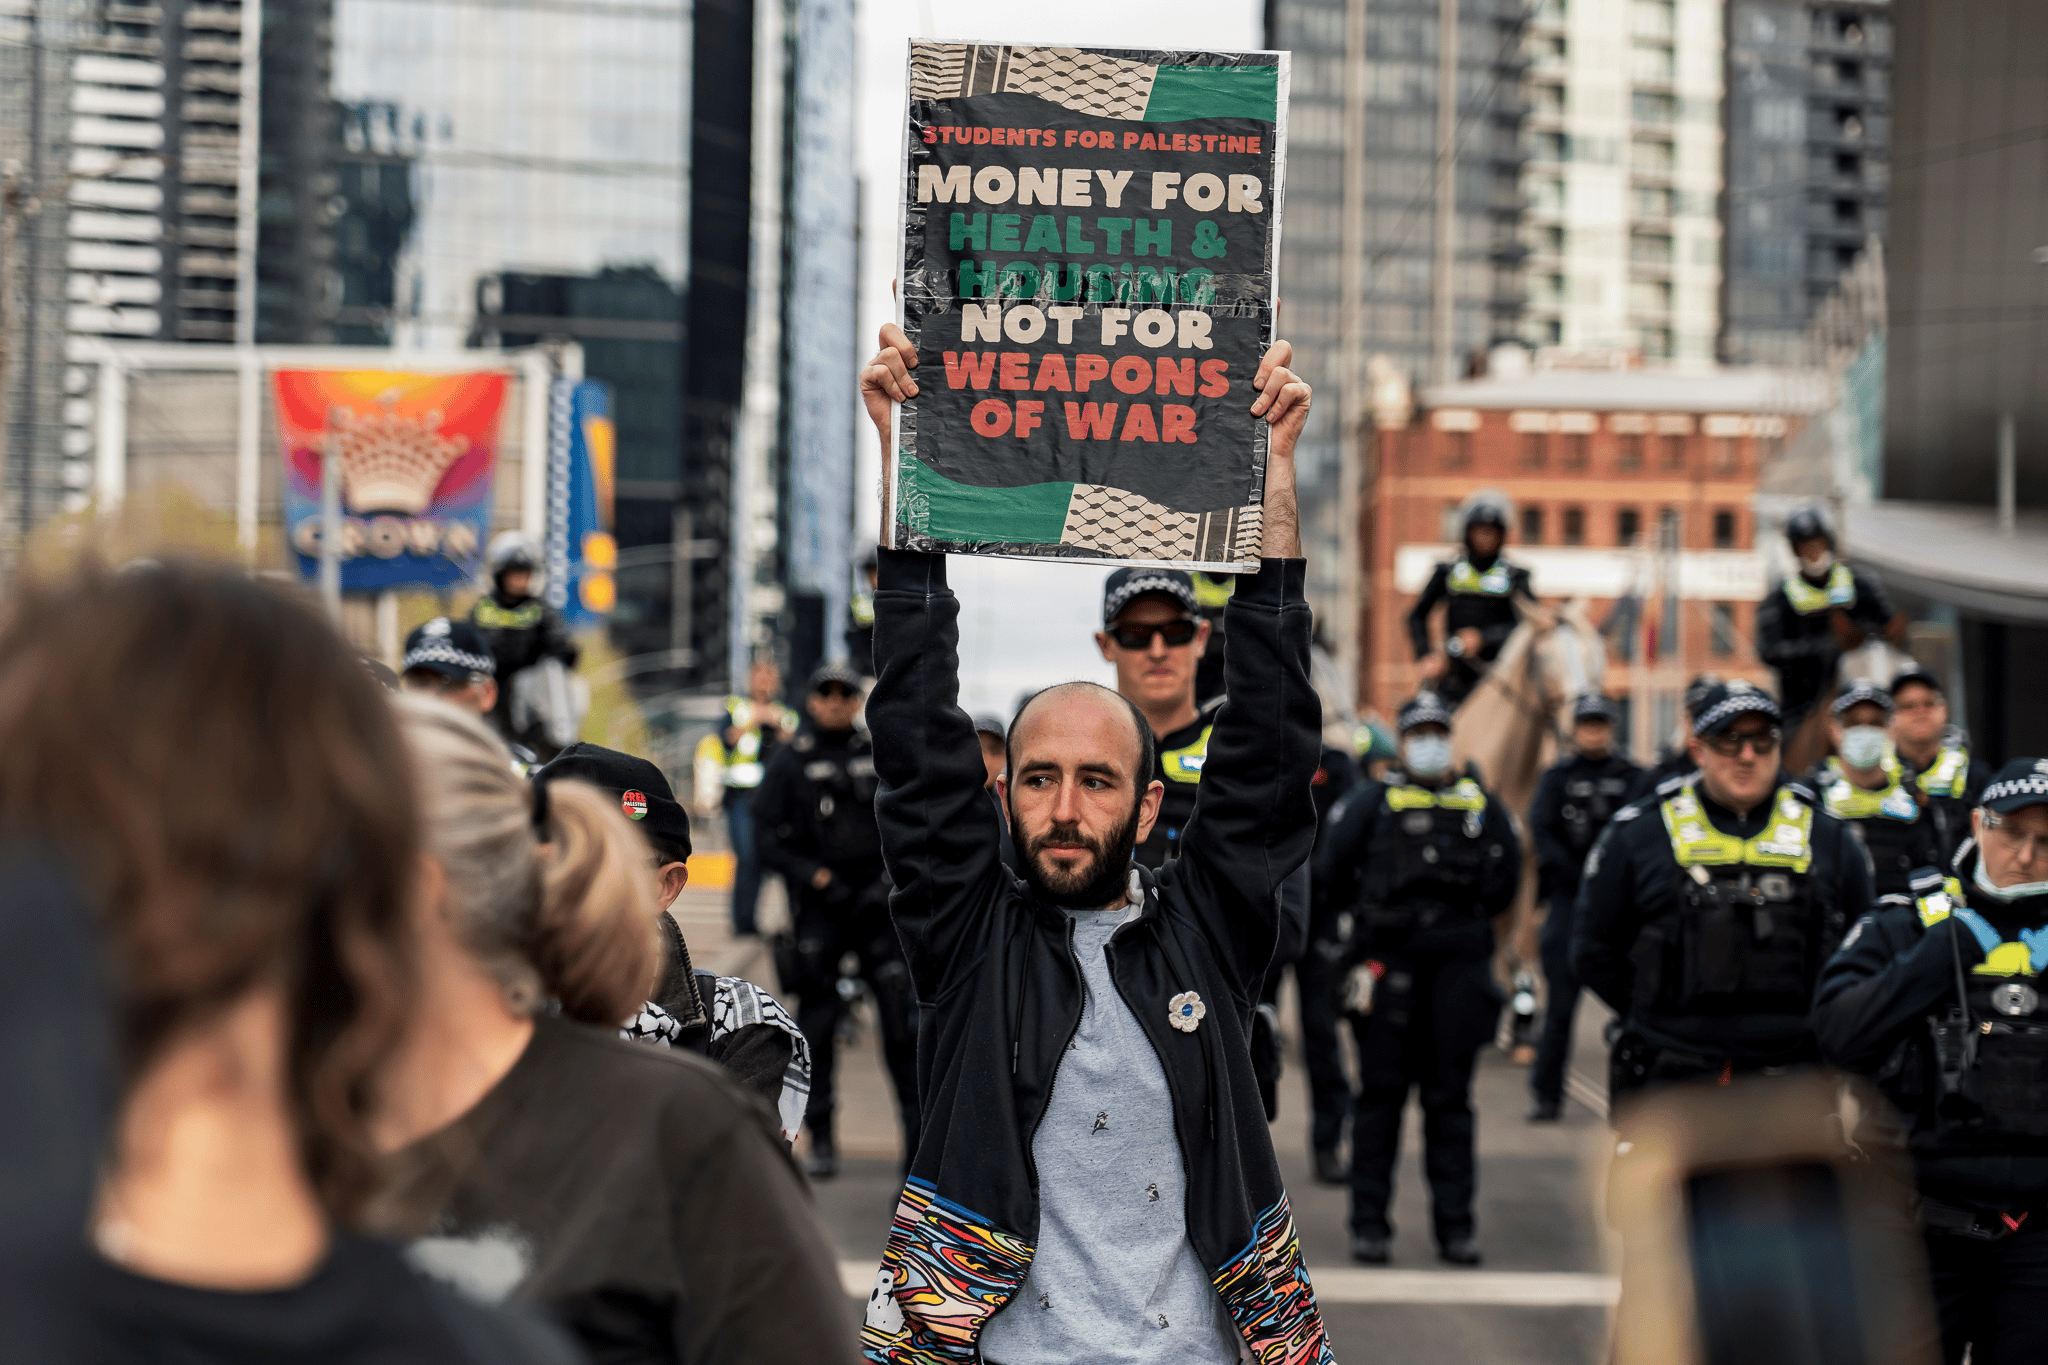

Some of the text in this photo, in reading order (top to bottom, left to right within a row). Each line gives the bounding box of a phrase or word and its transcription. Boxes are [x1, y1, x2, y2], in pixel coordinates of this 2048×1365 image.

[923, 125, 1057, 147] STUDENTS
[1064, 130, 1115, 149] FOR
[917, 164, 1263, 214] MONEY FOR
[949, 212, 1228, 259] HEALTH &
[961, 303, 1214, 350] NOT FOR
[942, 350, 1230, 398] WEAPONS
[970, 398, 1198, 444] OF WAR
[623, 791, 646, 803] FREE
